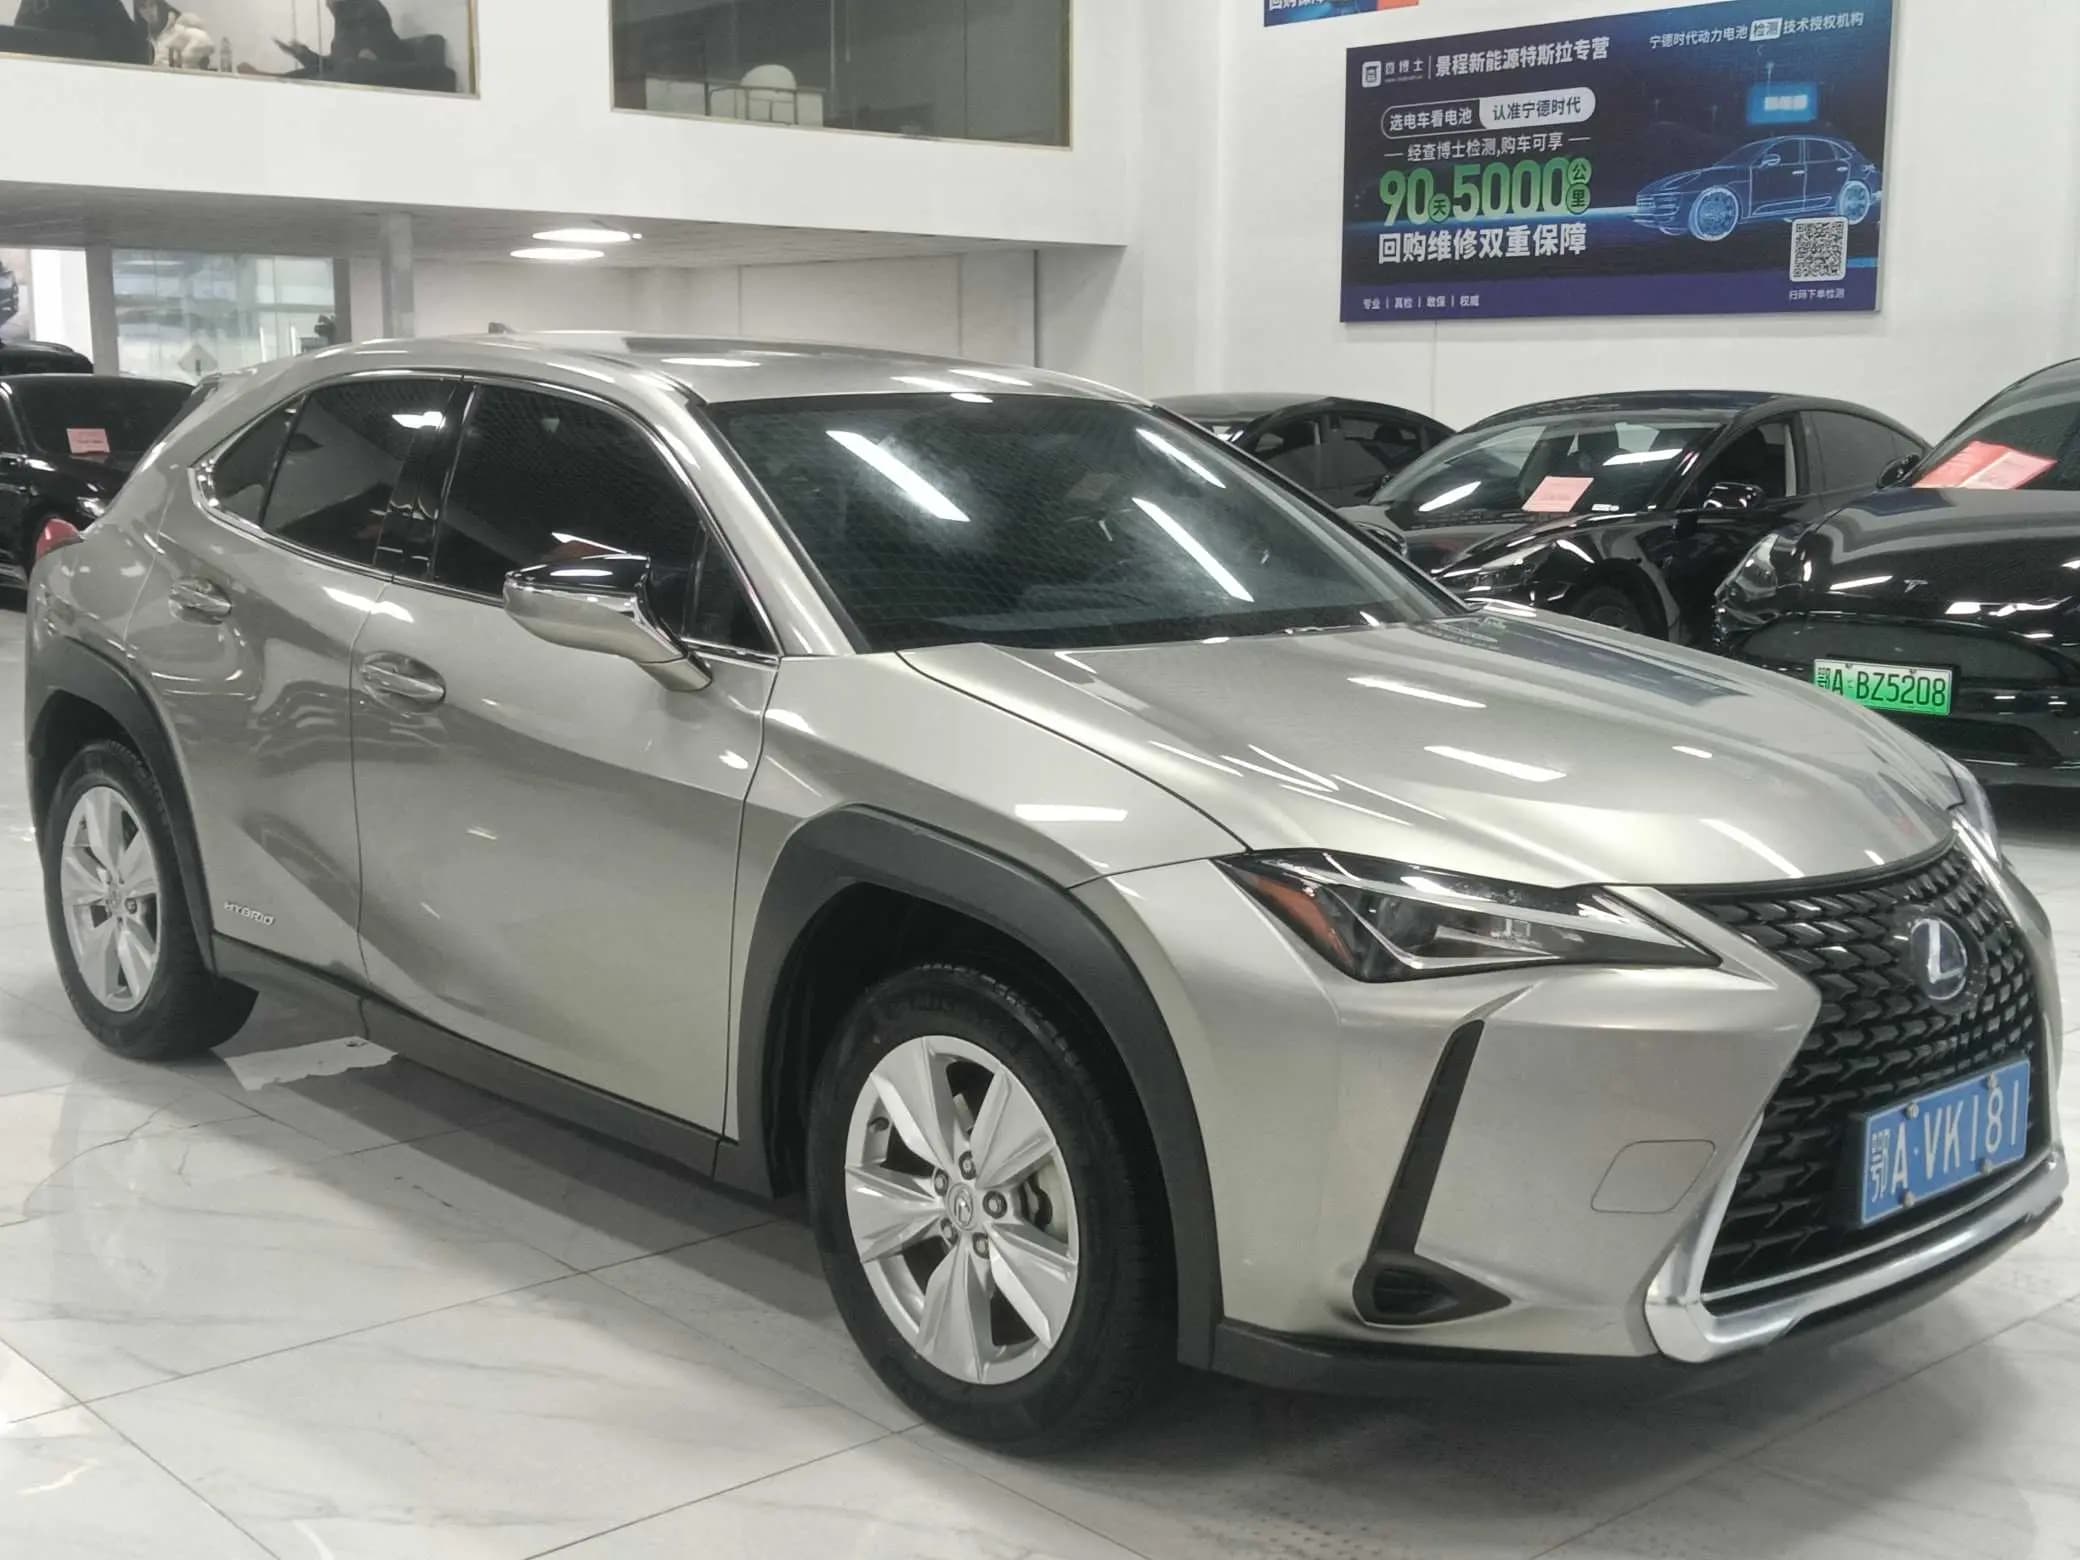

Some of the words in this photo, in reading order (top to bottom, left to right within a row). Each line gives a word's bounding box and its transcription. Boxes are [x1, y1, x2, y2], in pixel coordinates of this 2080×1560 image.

[1435, 36, 1610, 77] 景程新能源特斯拉专营
[1389, 107, 1473, 131] 选电车看电池
[1492, 97, 1582, 121] 认准宁德时代
[1378, 222, 1587, 264] 回购维修双重保障
[223, 901, 274, 926] HYBRID
